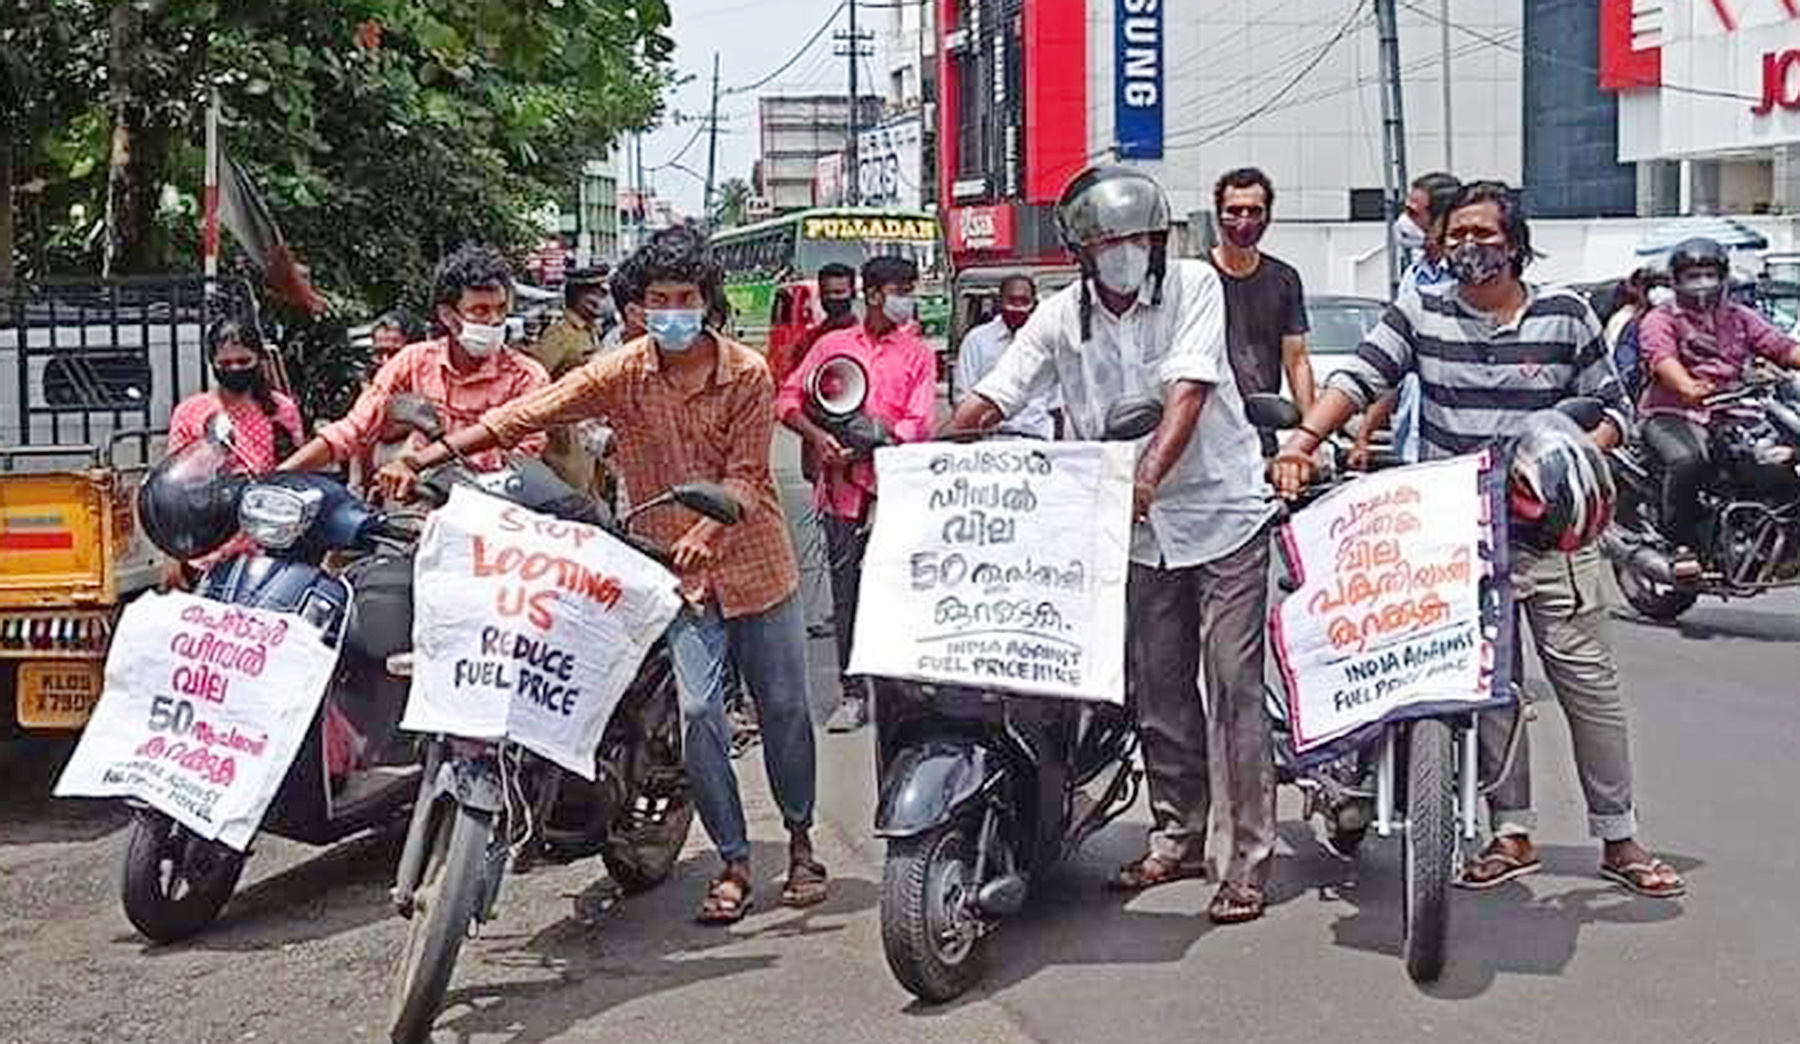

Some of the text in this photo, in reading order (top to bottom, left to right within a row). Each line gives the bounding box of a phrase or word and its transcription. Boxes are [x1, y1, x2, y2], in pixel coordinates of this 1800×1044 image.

[498, 506, 596, 548] STOP
[470, 534, 623, 613] LOOTING
[910, 552, 967, 590] 50
[495, 586, 561, 630] US
[482, 626, 576, 682] REDUCE
[1344, 652, 1400, 682] INDIA
[454, 659, 580, 717] FUEL PRICE
[150, 695, 194, 734] 50
